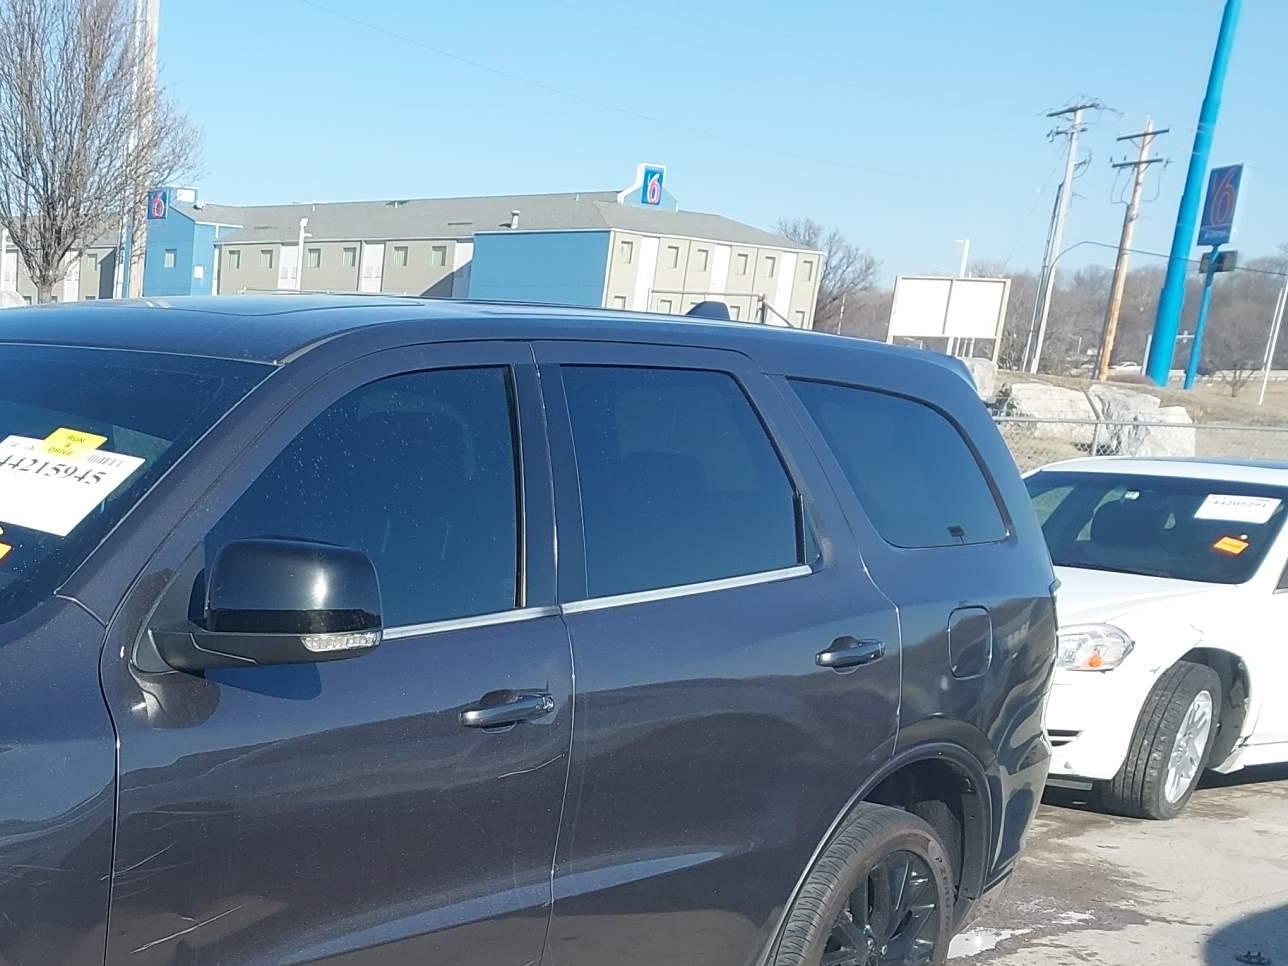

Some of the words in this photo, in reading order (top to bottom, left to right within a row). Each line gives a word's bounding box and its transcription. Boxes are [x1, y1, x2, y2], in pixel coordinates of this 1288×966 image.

[647, 173, 660, 204] 6
[1209, 167, 1236, 225] 6
[152, 192, 165, 218] 6
[48, 447, 74, 457] DRIVE
